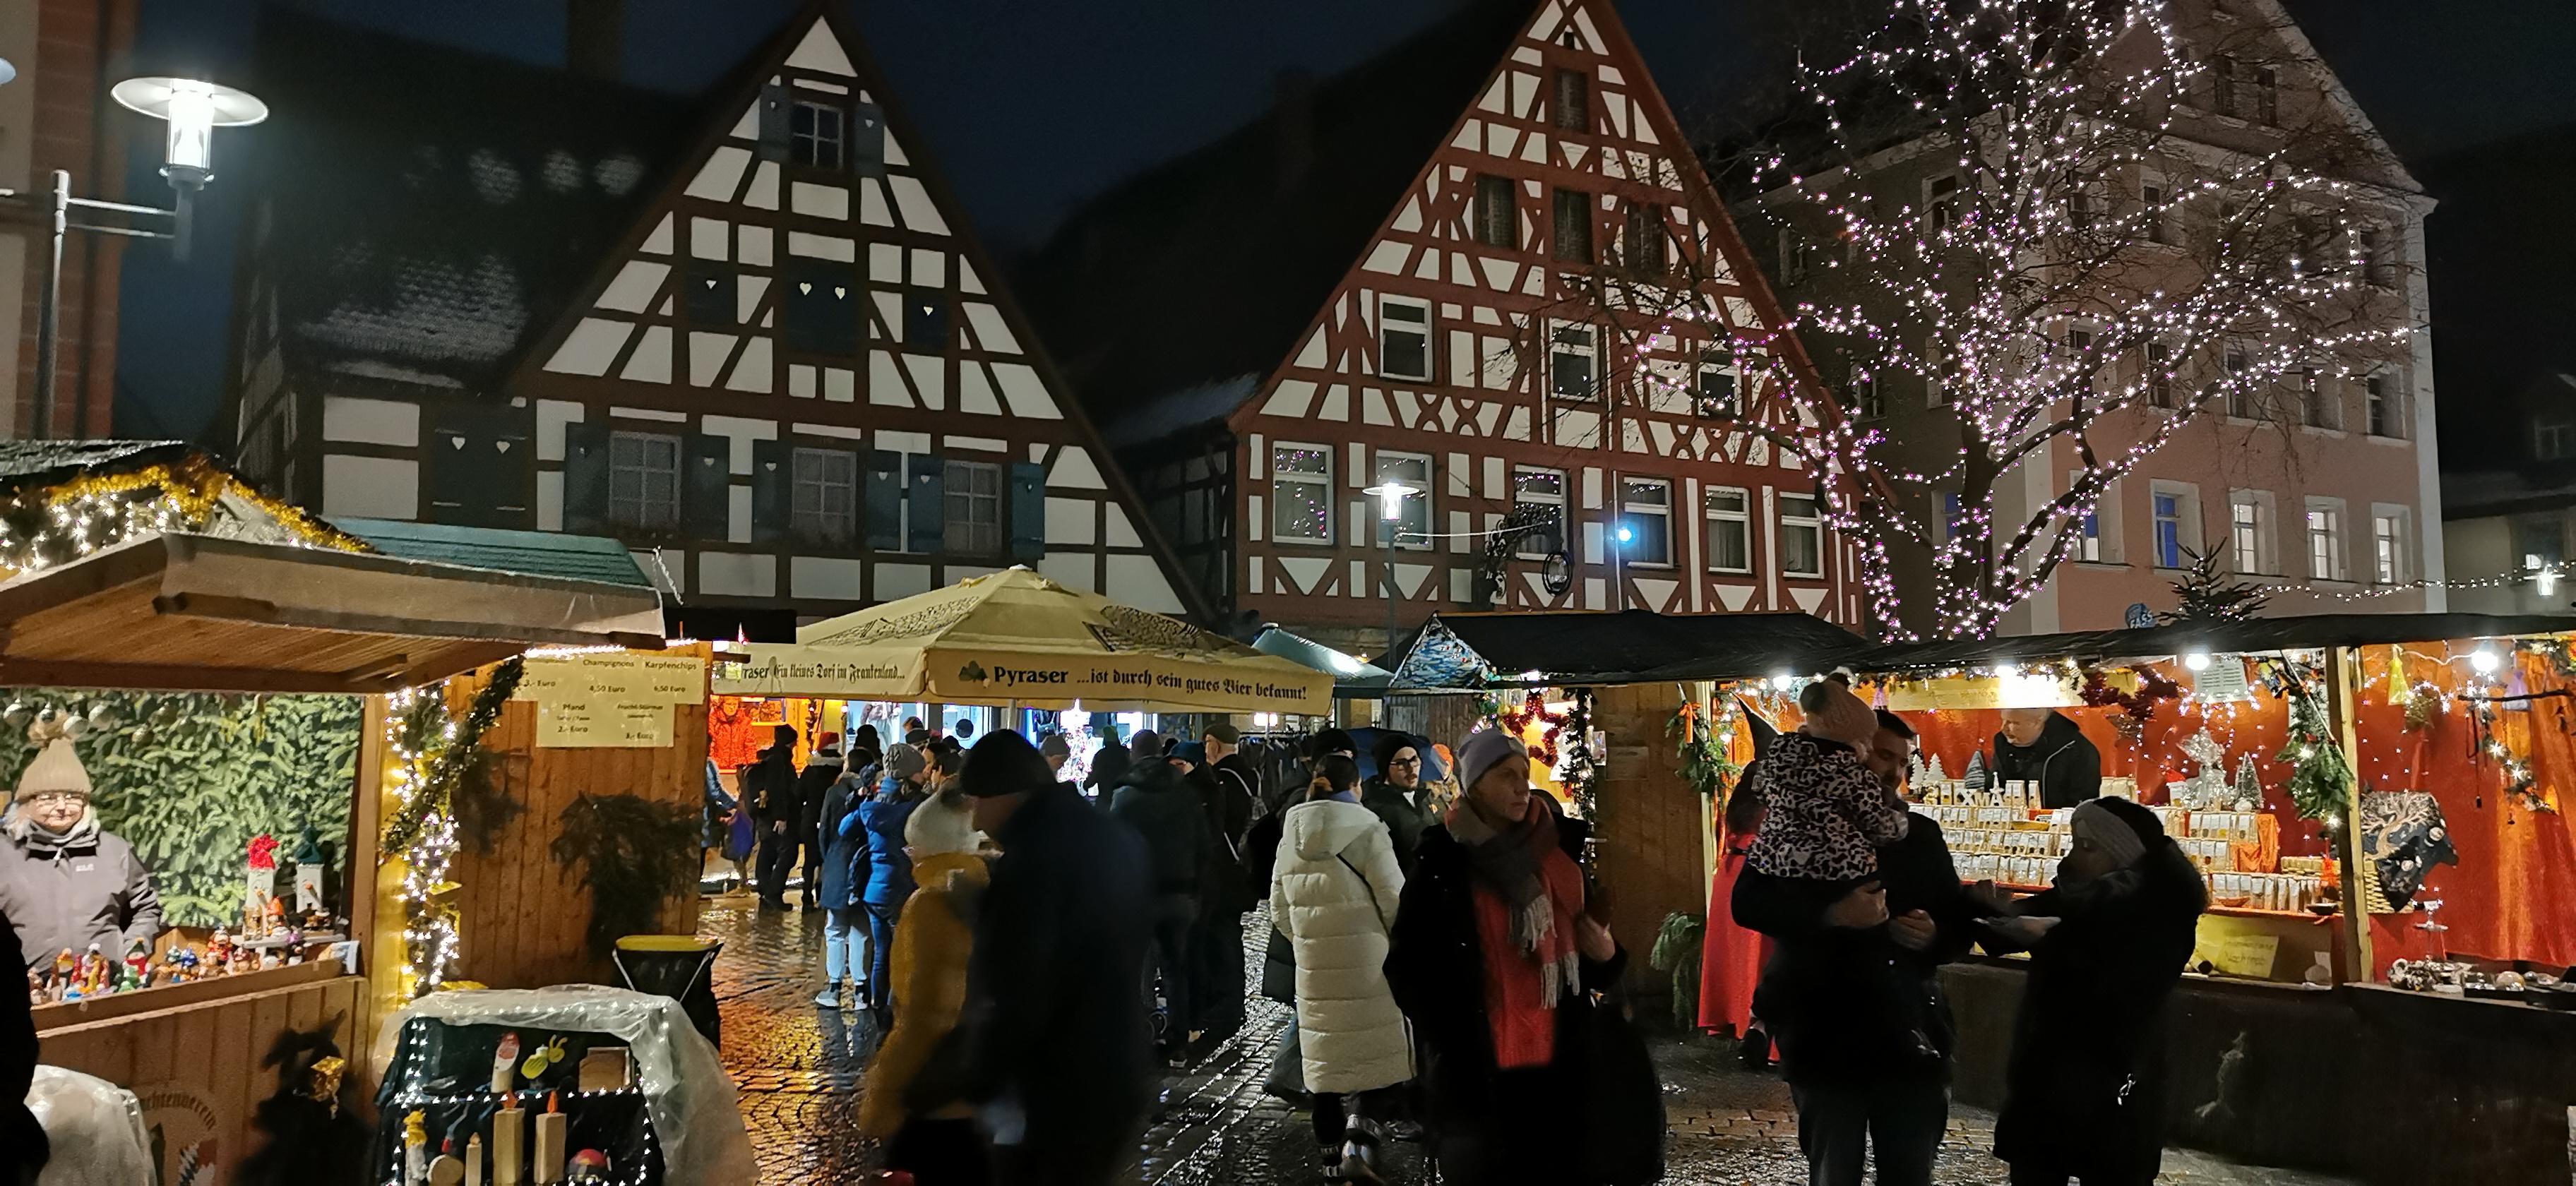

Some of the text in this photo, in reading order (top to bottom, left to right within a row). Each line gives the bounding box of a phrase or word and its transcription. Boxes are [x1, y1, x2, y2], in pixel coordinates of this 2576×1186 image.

[583, 659, 635, 668] Champignons
[645, 661, 697, 670] Karpfenchips
[739, 666, 770, 683] raser
[817, 664, 835, 681] Dorf
[837, 664, 847, 679] im
[994, 666, 1069, 687] Pyraser
[1114, 669, 1152, 688] durch
[1157, 673, 1182, 689] sein
[1186, 678, 1220, 695] gutes
[1223, 678, 1253, 695] Bier
[1256, 683, 1307, 700] bekannt!
